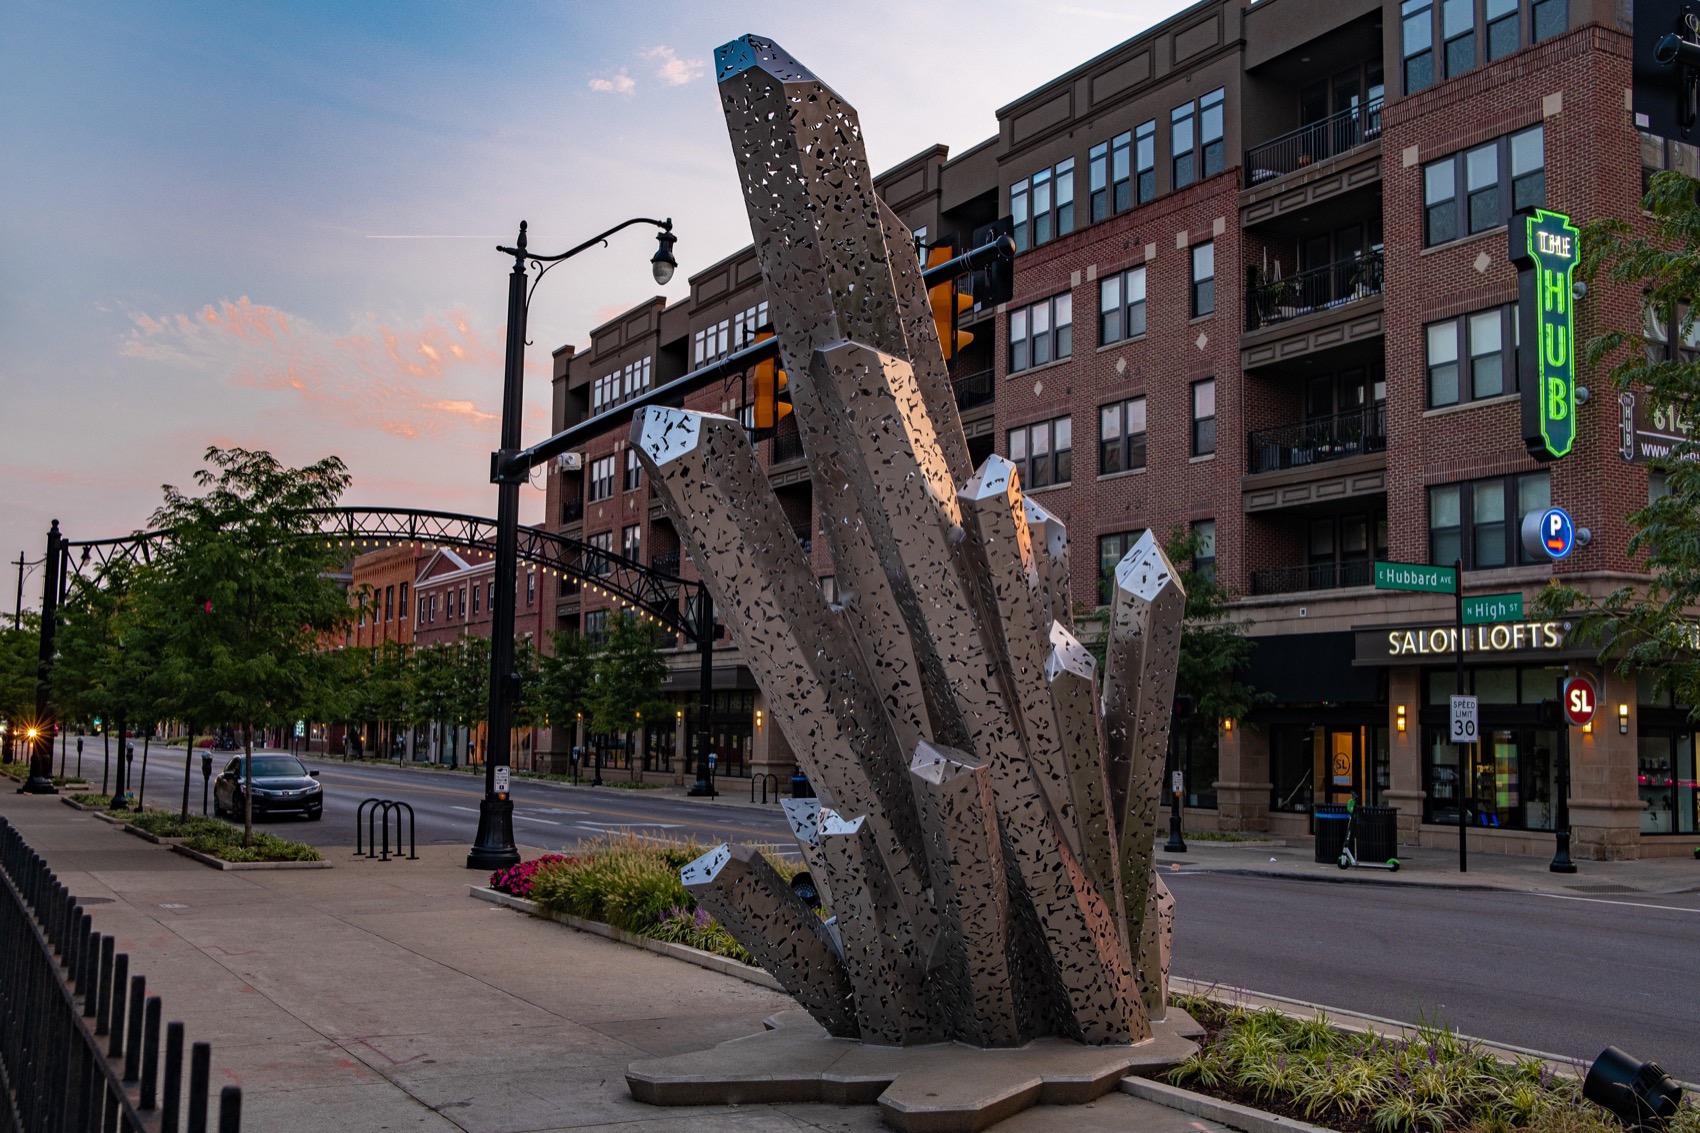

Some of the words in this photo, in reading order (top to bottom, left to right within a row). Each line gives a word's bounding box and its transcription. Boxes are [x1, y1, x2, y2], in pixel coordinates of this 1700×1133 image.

[1537, 231, 1571, 258] THE
[1545, 269, 1567, 421] HUB
[1550, 514, 1562, 536] P
[1379, 571, 1383, 579] E
[1386, 568, 1437, 586] Hubbard
[1440, 576, 1452, 585] AVE
[1467, 607, 1472, 615] N
[1475, 602, 1506, 620] High
[1509, 603, 1518, 612] ST
[1388, 628, 1467, 655] SALON
[1478, 622, 1558, 651] LOFTS
[1453, 700, 1476, 709] SPEED
[1570, 690, 1592, 713] SL
[1455, 710, 1473, 718] LIMIT
[1454, 719, 1475, 736] 30
[1336, 758, 1348, 770] SL
